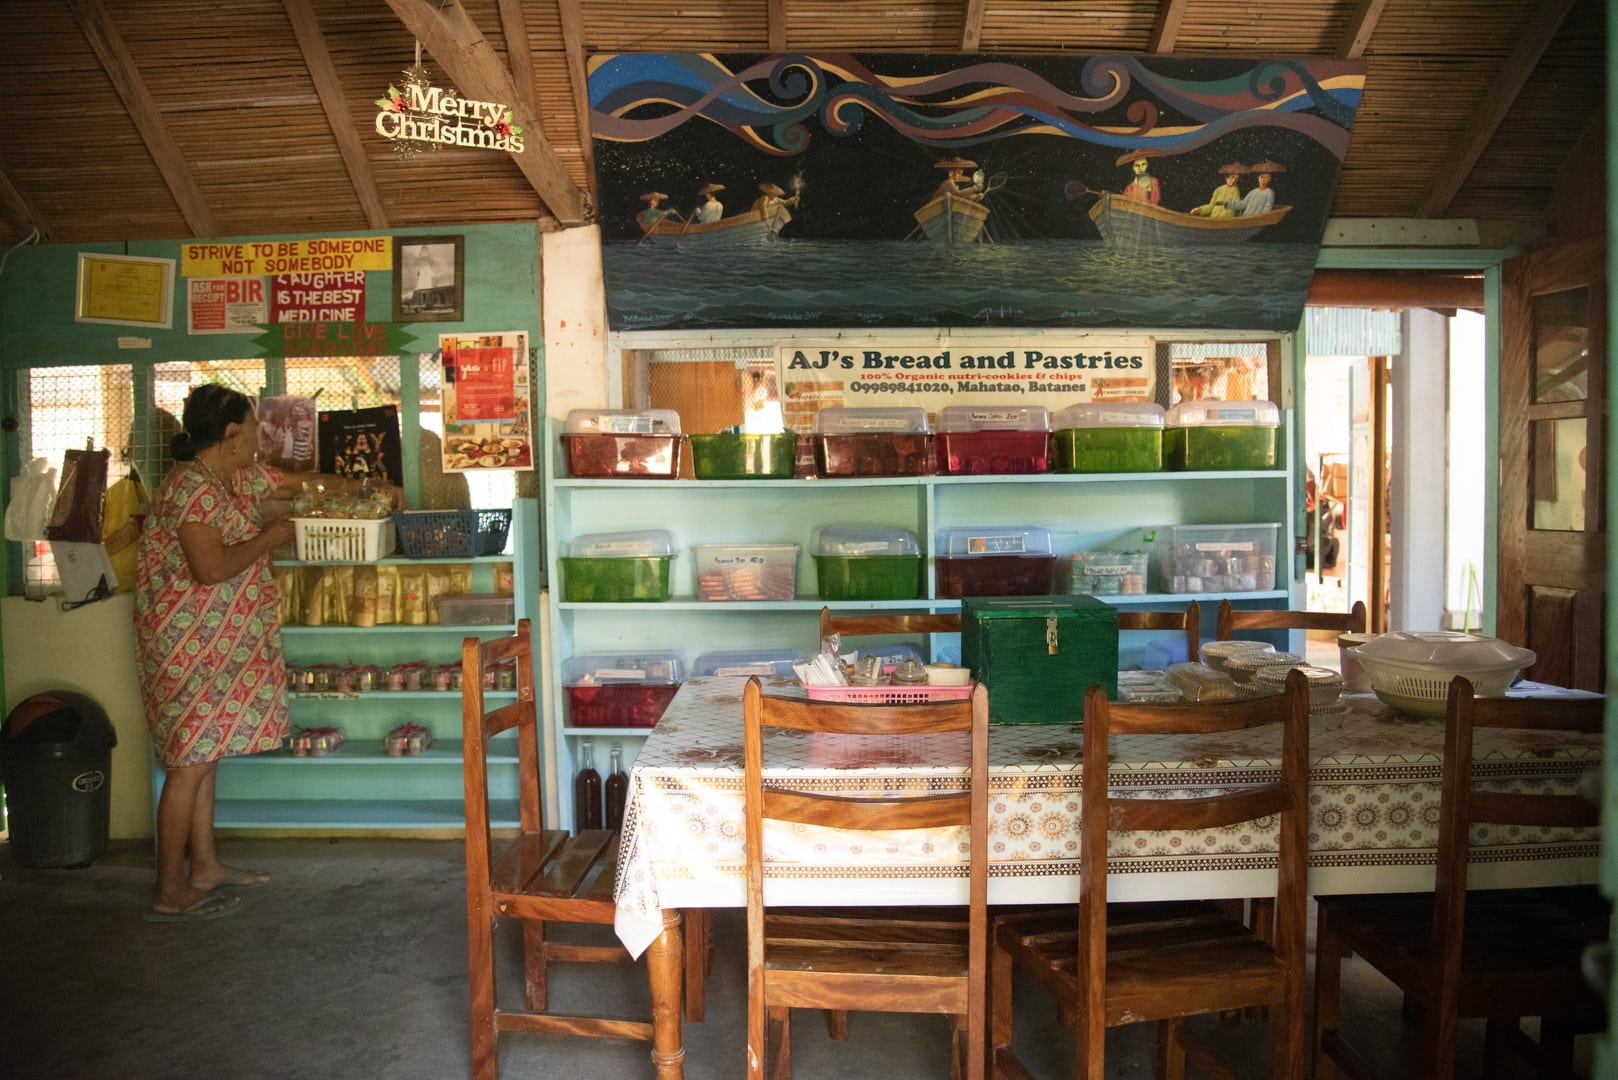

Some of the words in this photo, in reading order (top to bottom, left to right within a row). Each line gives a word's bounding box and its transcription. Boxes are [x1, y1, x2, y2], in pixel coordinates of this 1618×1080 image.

[408, 84, 507, 127] Merry
[375, 112, 525, 153] Christmas
[189, 246, 243, 260] STRIVE
[252, 244, 273, 257] TO
[278, 243, 299, 256] BE
[308, 239, 384, 255] SOMEONE
[222, 260, 254, 274] NOT
[265, 255, 354, 273] SOMEBODY
[193, 283, 211, 293] ASK
[227, 280, 263, 303] BIR
[277, 291, 291, 304] IS
[278, 308, 356, 323] MEDICINE
[284, 324, 327, 339] GIVE
[338, 324, 385, 340] LOVE
[285, 342, 387, 358] EVERYDAY
[787, 351, 854, 369] AJ's
[862, 351, 951, 369] Bread
[959, 351, 1016, 369] and
[1024, 351, 1143, 369] Pastries
[895, 373, 945, 381] Organic
[1049, 373, 1083, 382] chips
[957, 381, 1025, 394] Mahatao,
[1028, 381, 1086, 392] Batanes
